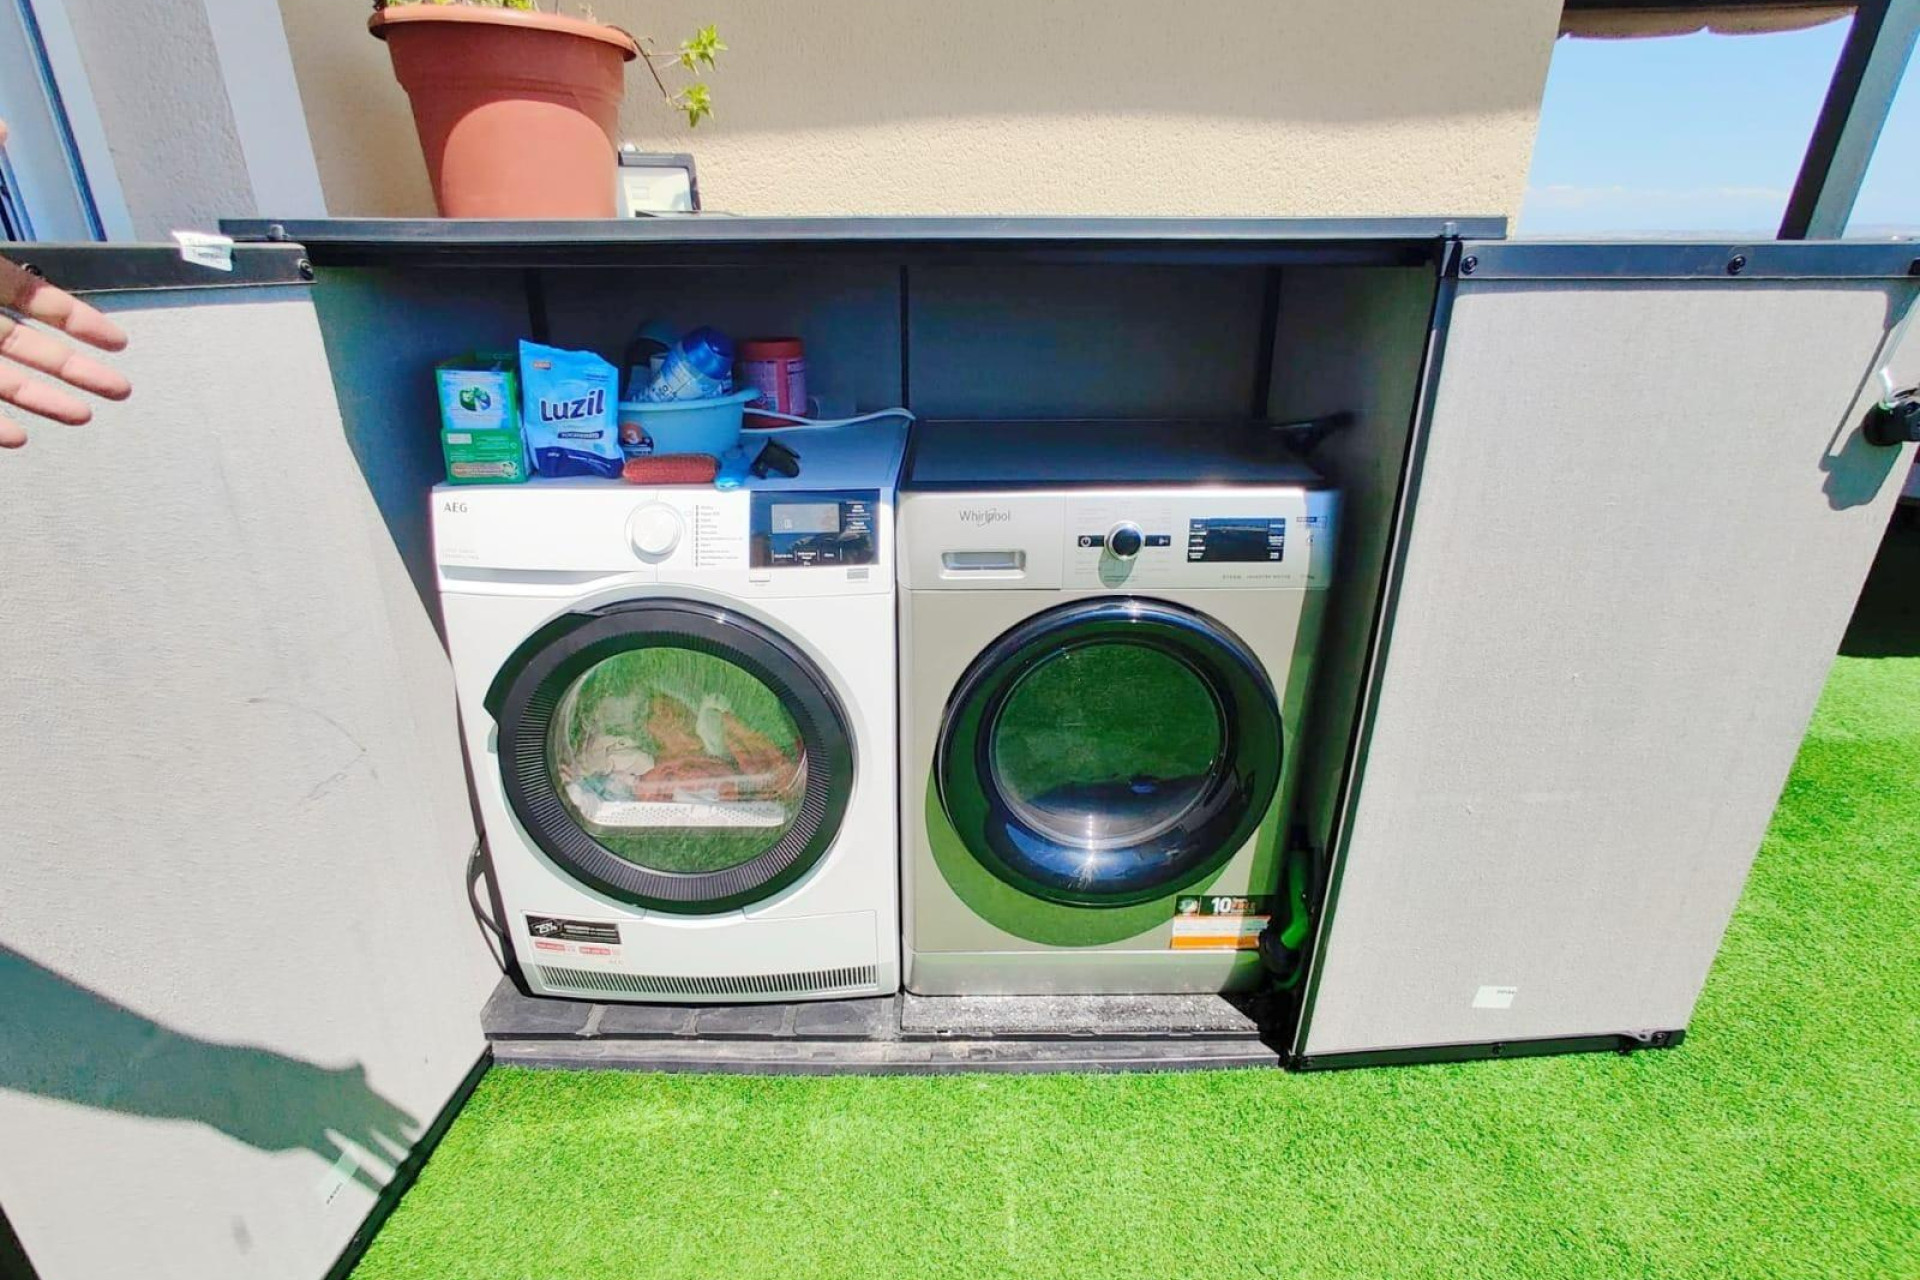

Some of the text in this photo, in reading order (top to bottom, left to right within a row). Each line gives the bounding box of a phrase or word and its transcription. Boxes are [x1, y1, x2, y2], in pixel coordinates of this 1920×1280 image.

[540, 390, 604, 421] Luzil
[443, 502, 468, 513] AEG
[959, 508, 1010, 526] Whirlpool
[1211, 897, 1231, 913] 10
